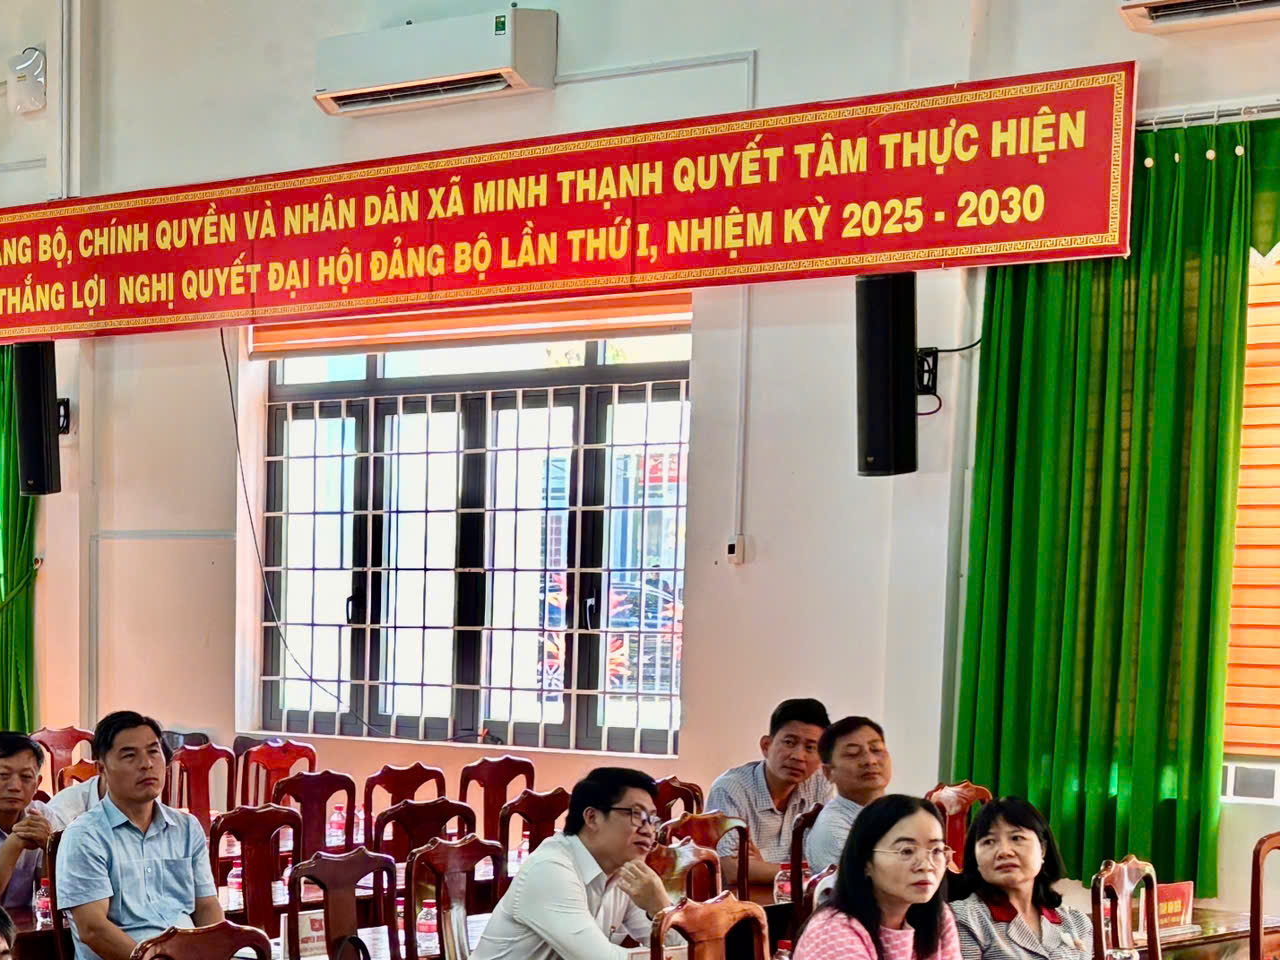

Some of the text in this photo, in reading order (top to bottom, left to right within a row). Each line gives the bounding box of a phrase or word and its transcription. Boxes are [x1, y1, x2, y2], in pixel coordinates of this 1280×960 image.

[38, 229, 74, 269] BỘ,
[79, 216, 149, 258] CHÍNH
[156, 201, 236, 249] QUYỀN
[245, 202, 276, 240] VÀ
[283, 194, 357, 237] NHÂN
[364, 187, 419, 226] DÂN
[427, 176, 464, 219] XÃ
[473, 174, 547, 215] MINH
[557, 161, 663, 211] THẠNH
[673, 134, 784, 193] QUYẾT
[794, 132, 868, 178] TÂM
[880, 118, 978, 175] THỰC
[991, 107, 1087, 164] HIỆN
[72, 277, 106, 316] LỢI
[119, 272, 175, 310] NGHỊ
[182, 253, 260, 300] QUYẾT
[267, 260, 310, 296] ĐẠI
[317, 247, 362, 293] HỘI
[369, 237, 445, 283] ĐẢNG
[453, 231, 492, 281] BỘ
[501, 221, 558, 269] LẦN
[568, 219, 631, 263] THỨ
[636, 230, 658, 264] I,
[666, 206, 771, 259] NHIỆM
[783, 196, 831, 243] KỲ
[841, 197, 924, 239] 2025
[935, 211, 946, 222] -
[957, 184, 1045, 228] 2030
